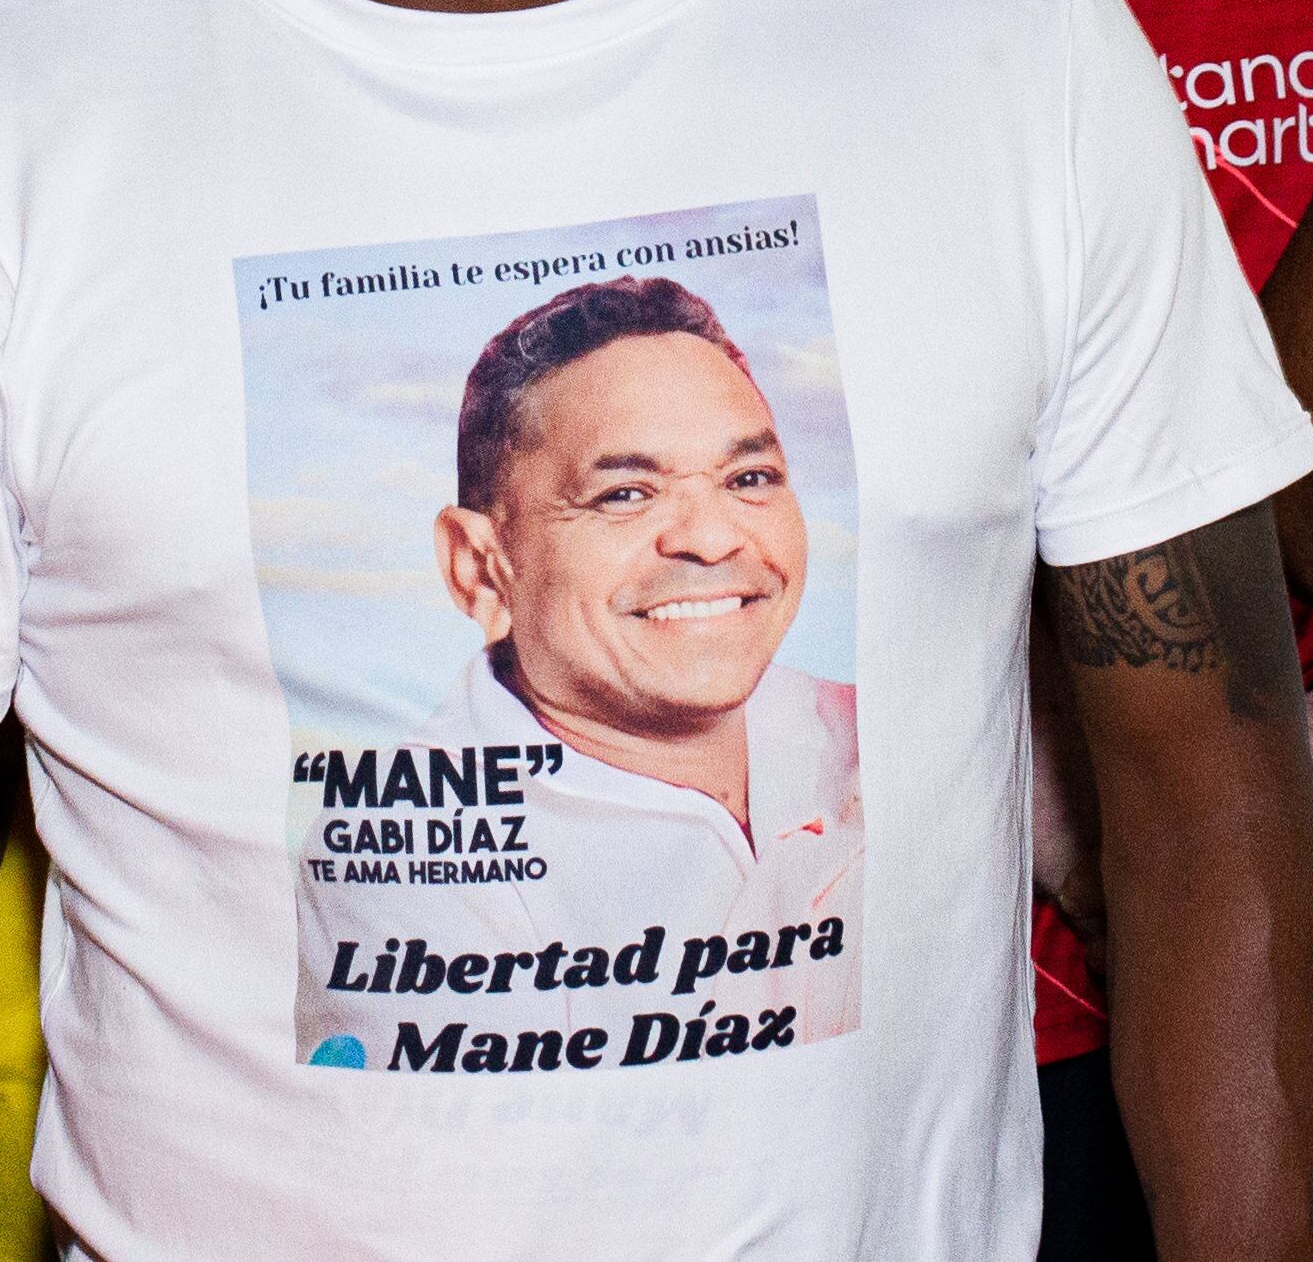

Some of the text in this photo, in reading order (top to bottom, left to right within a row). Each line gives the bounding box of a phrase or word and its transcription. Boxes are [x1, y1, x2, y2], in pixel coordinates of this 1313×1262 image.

[258, 219, 800, 310] ¡Tu familia te espera con ansias!
[293, 743, 564, 808] “MANE”
[323, 807, 529, 855] GABI DÍAZ
[307, 856, 548, 884] TE AMA HERMANO
[326, 915, 846, 996] Libertad para
[386, 999, 798, 1074] Mane Díaz
